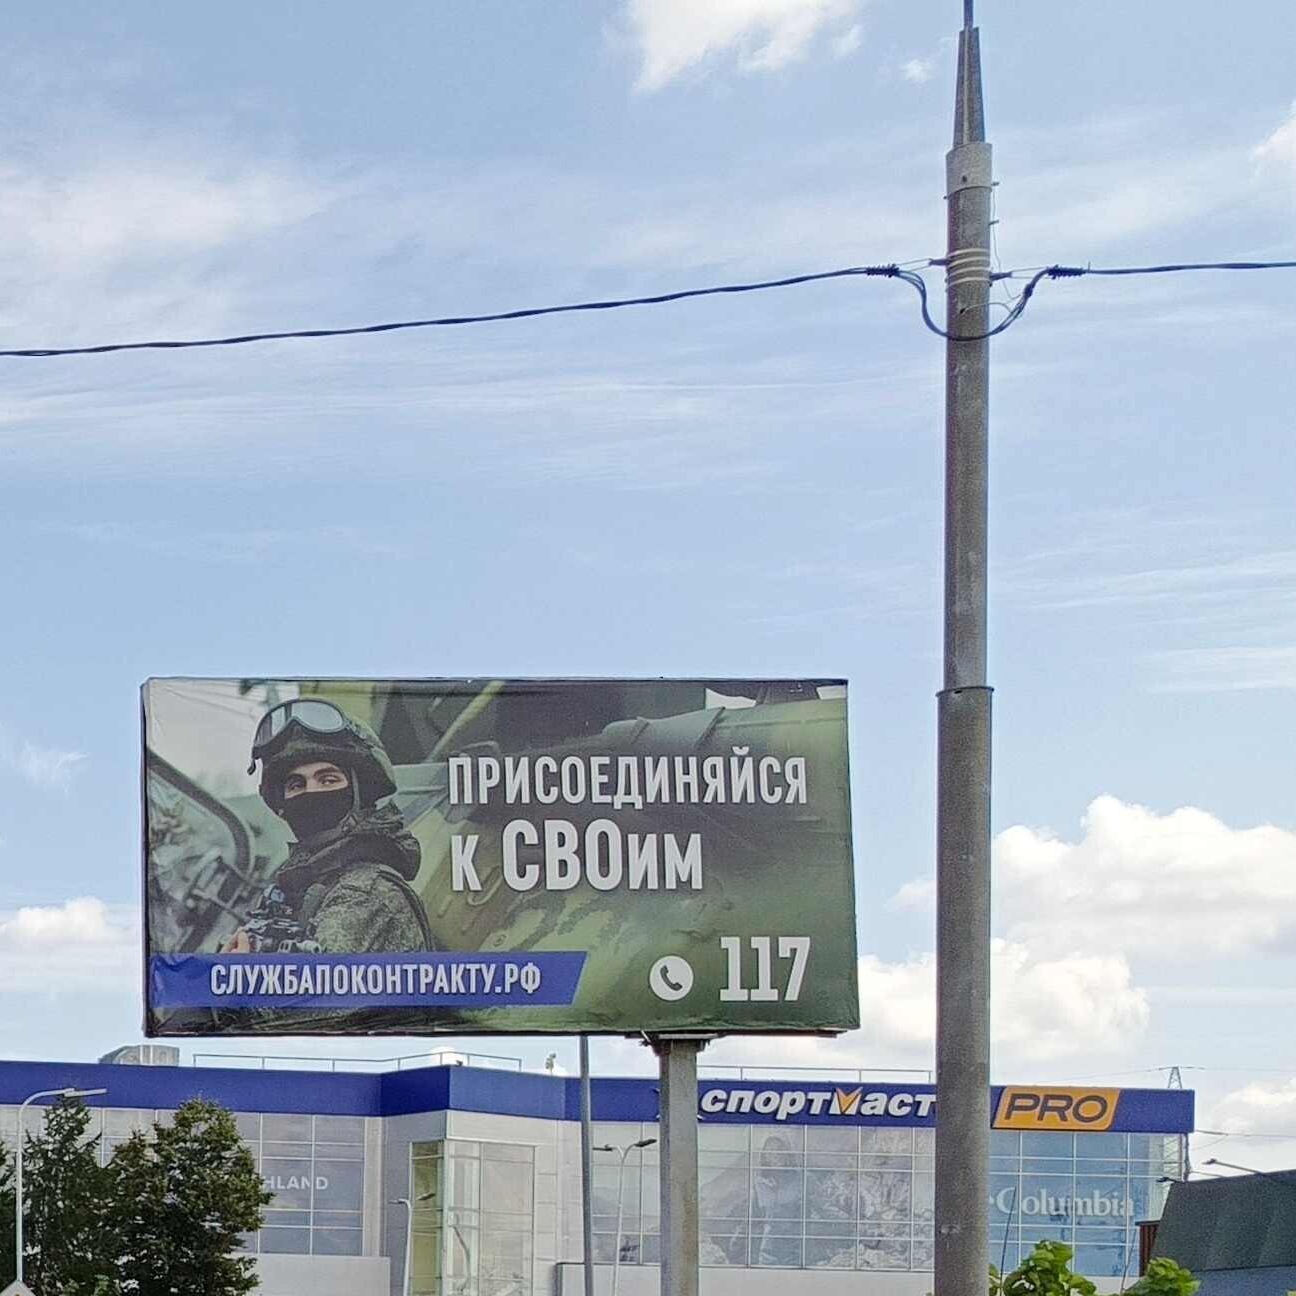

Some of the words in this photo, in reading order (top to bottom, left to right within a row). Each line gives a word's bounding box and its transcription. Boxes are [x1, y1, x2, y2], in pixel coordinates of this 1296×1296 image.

[448, 746, 808, 809] ПРИСОЕДИНЯЙСЯ
[210, 962, 542, 996] СЛУЖБАПОКОНТРАКТУ.РФ
[719, 936, 811, 1001] 117
[1005, 1093, 1108, 1124] PRO
[262, 1175, 330, 1191] HLAND
[996, 1186, 1135, 1217] Columbia
